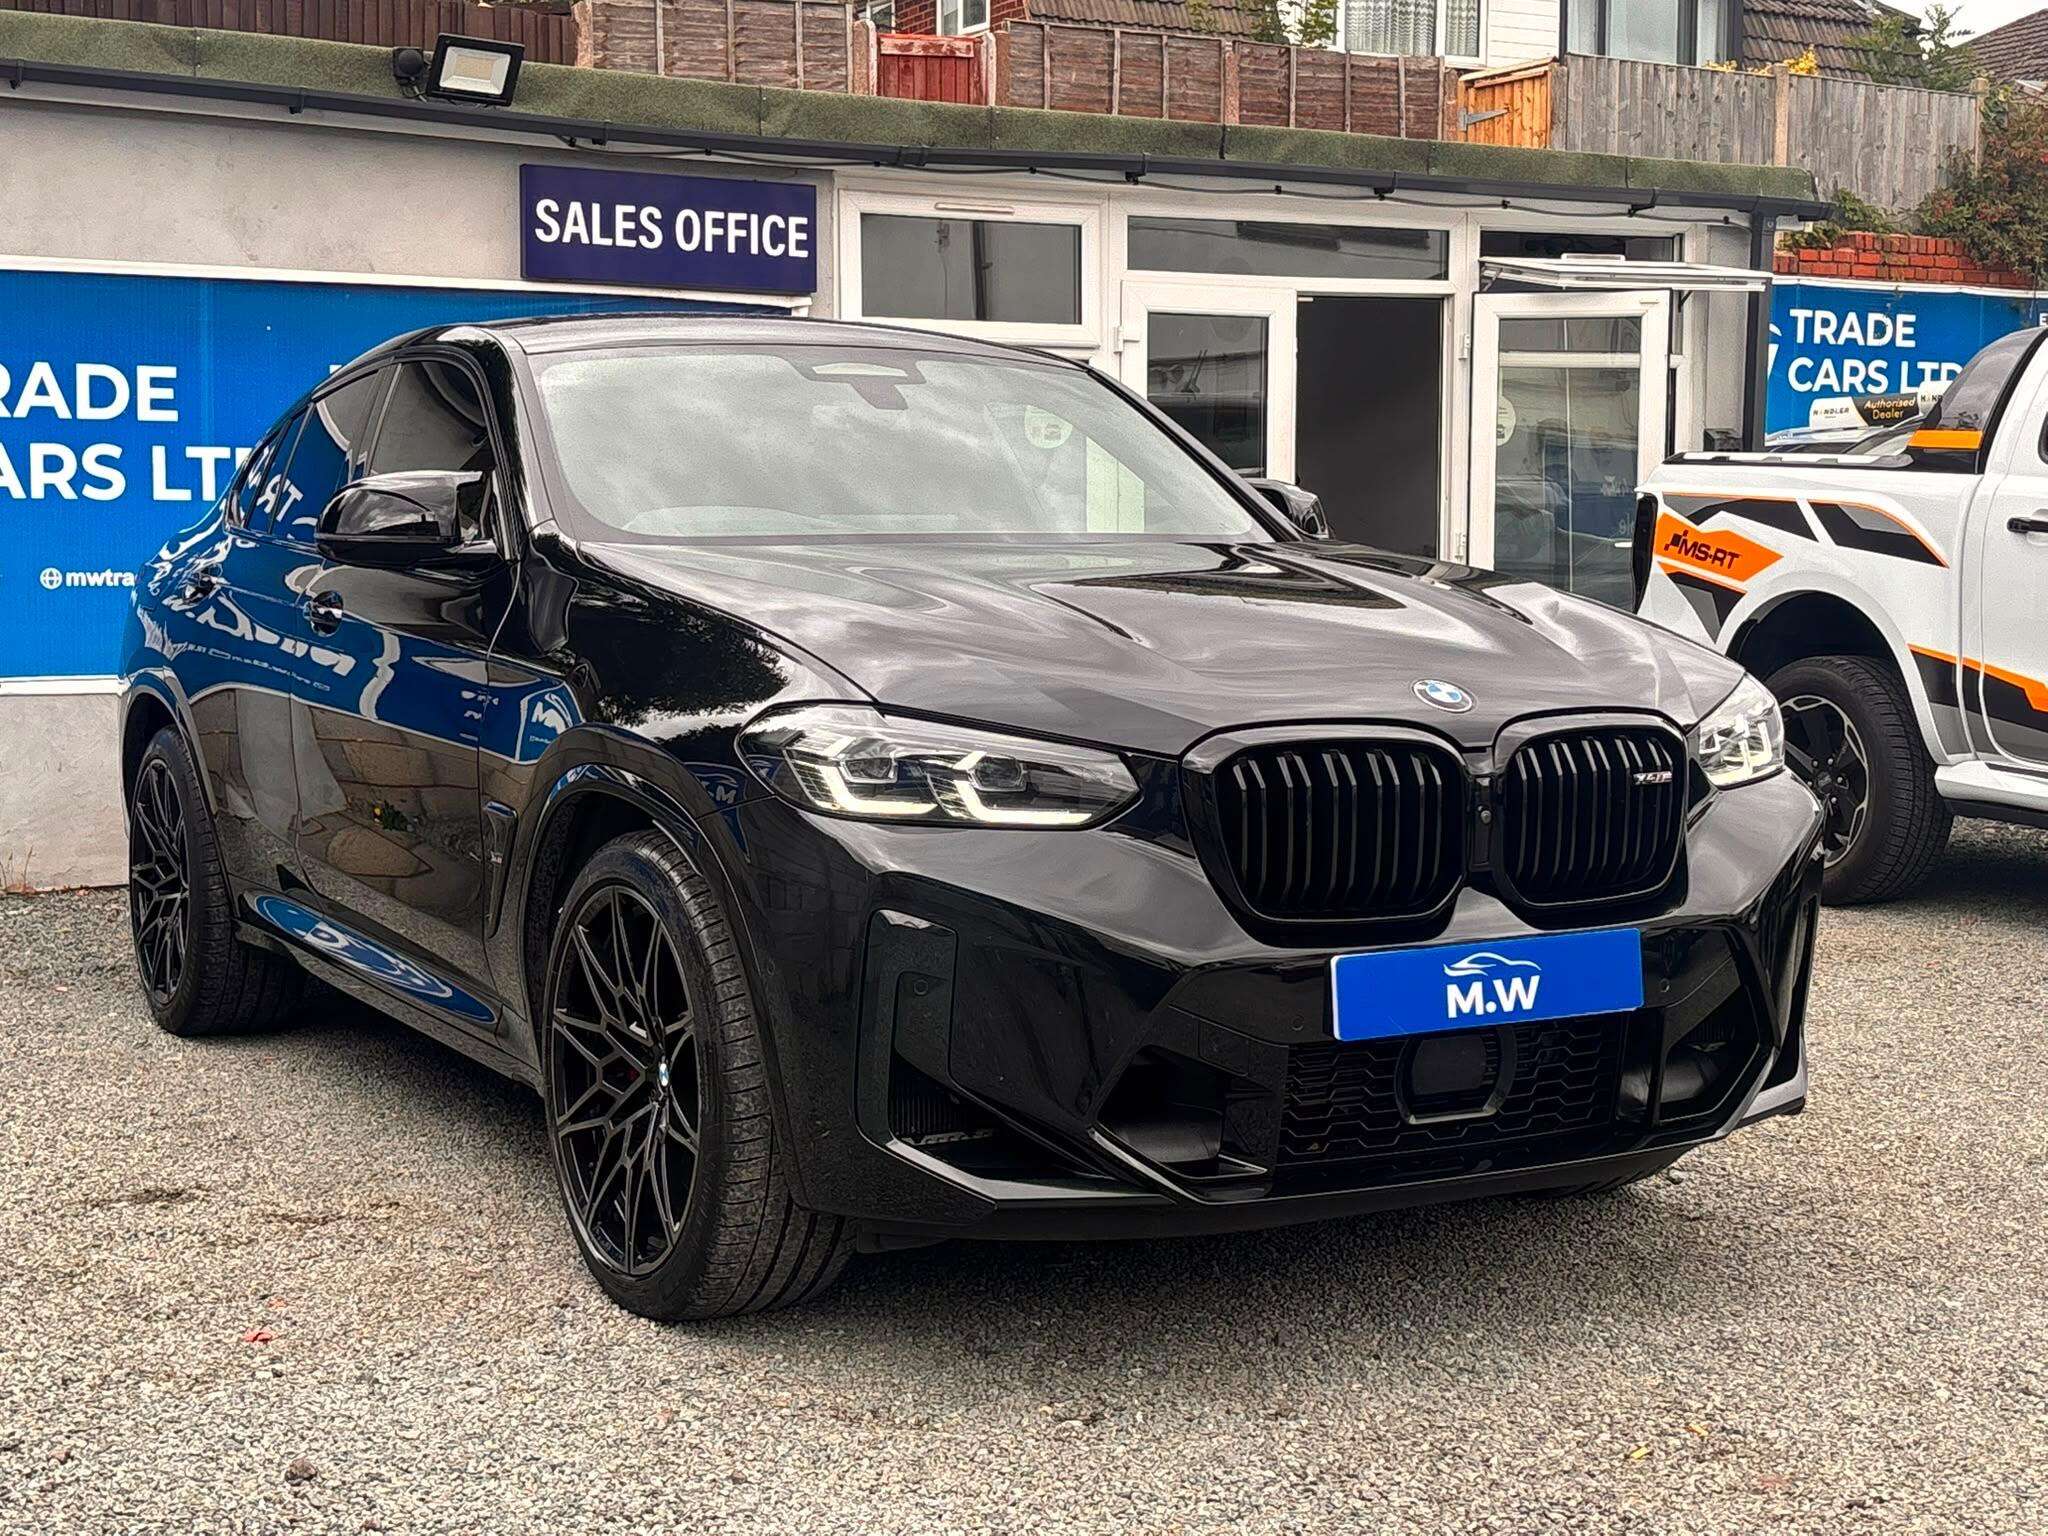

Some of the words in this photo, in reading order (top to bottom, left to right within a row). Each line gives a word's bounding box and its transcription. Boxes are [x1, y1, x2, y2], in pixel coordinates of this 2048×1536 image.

[535, 199, 663, 249] SALES
[675, 208, 809, 258] OFFICE
[1789, 309, 1916, 348] TRADE
[0, 362, 178, 422] ADE
[1787, 357, 1888, 394] CARS
[1864, 397, 1916, 409] Authorised
[1872, 410, 1904, 420] Dealer
[152, 445, 252, 502] LT
[66, 569, 137, 587] mwtra
[1446, 975, 1541, 1018] M.W
